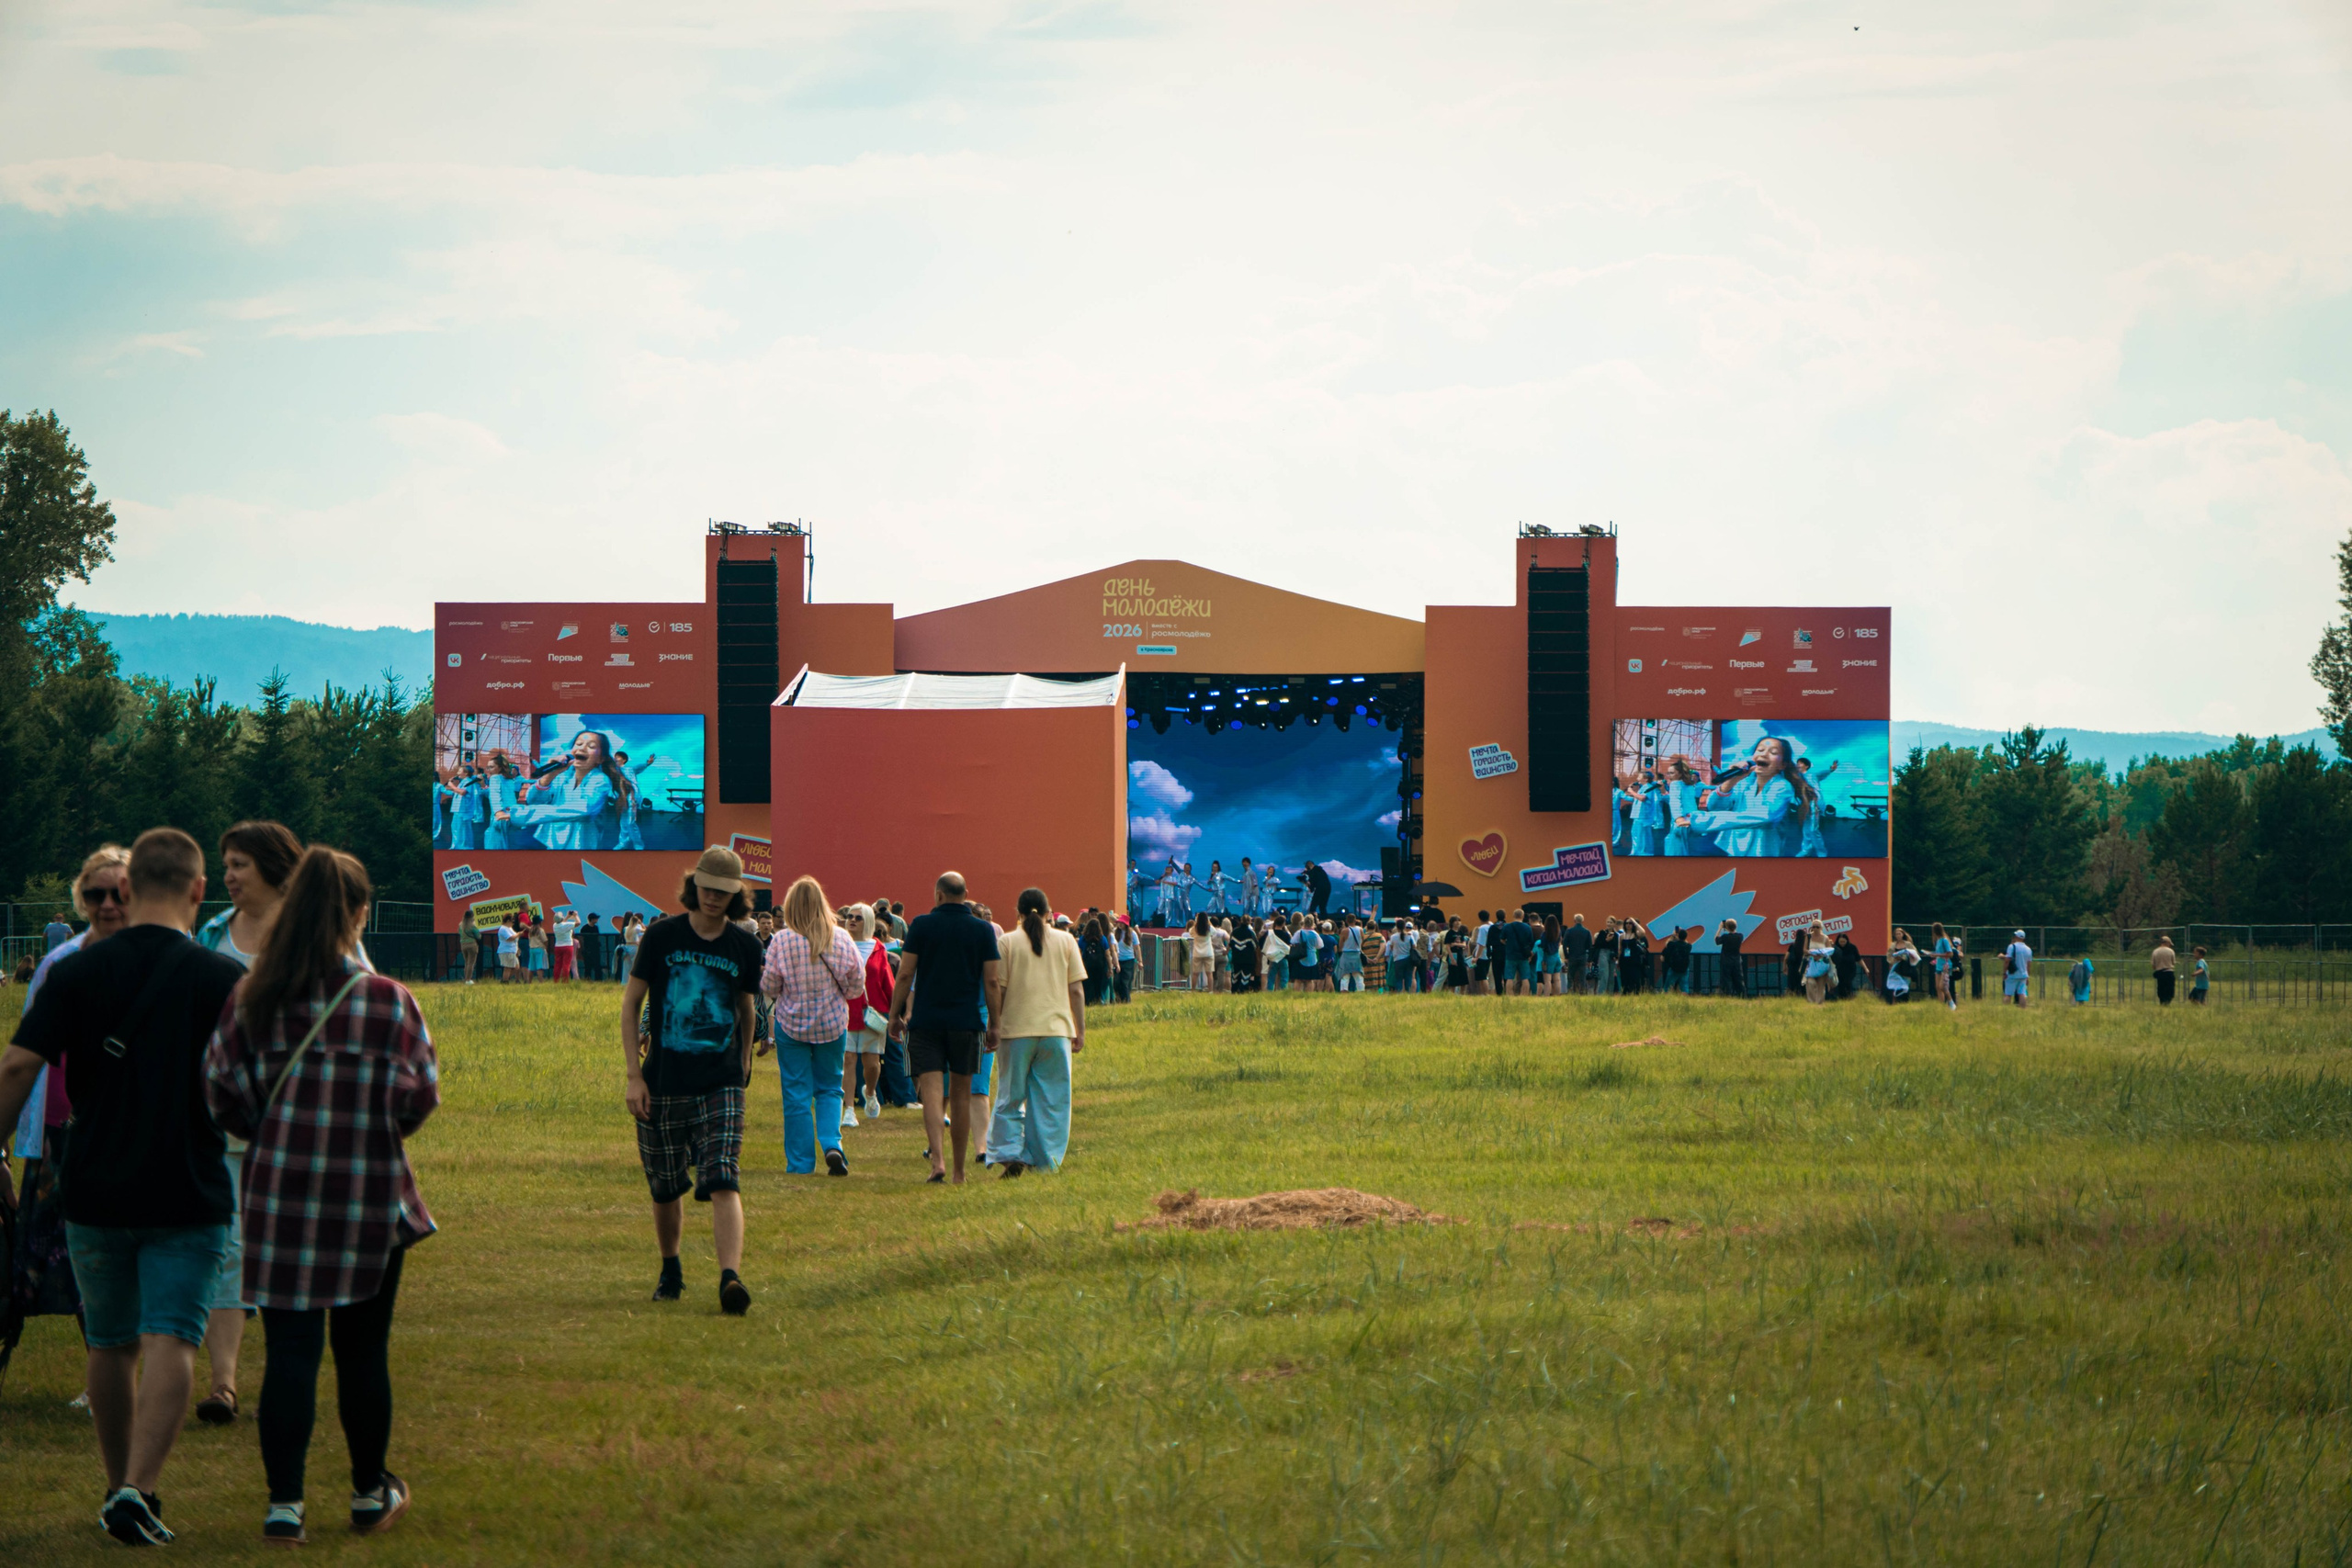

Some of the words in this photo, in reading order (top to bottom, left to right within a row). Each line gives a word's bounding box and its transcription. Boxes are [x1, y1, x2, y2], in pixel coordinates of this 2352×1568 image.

[669, 623, 693, 632] 185
[1102, 624, 1142, 637] 2026
[1151, 630, 1211, 638] росмолодёжь
[1854, 628, 1879, 638] 185
[548, 653, 582, 663] Первые
[1729, 660, 1765, 670] Первые
